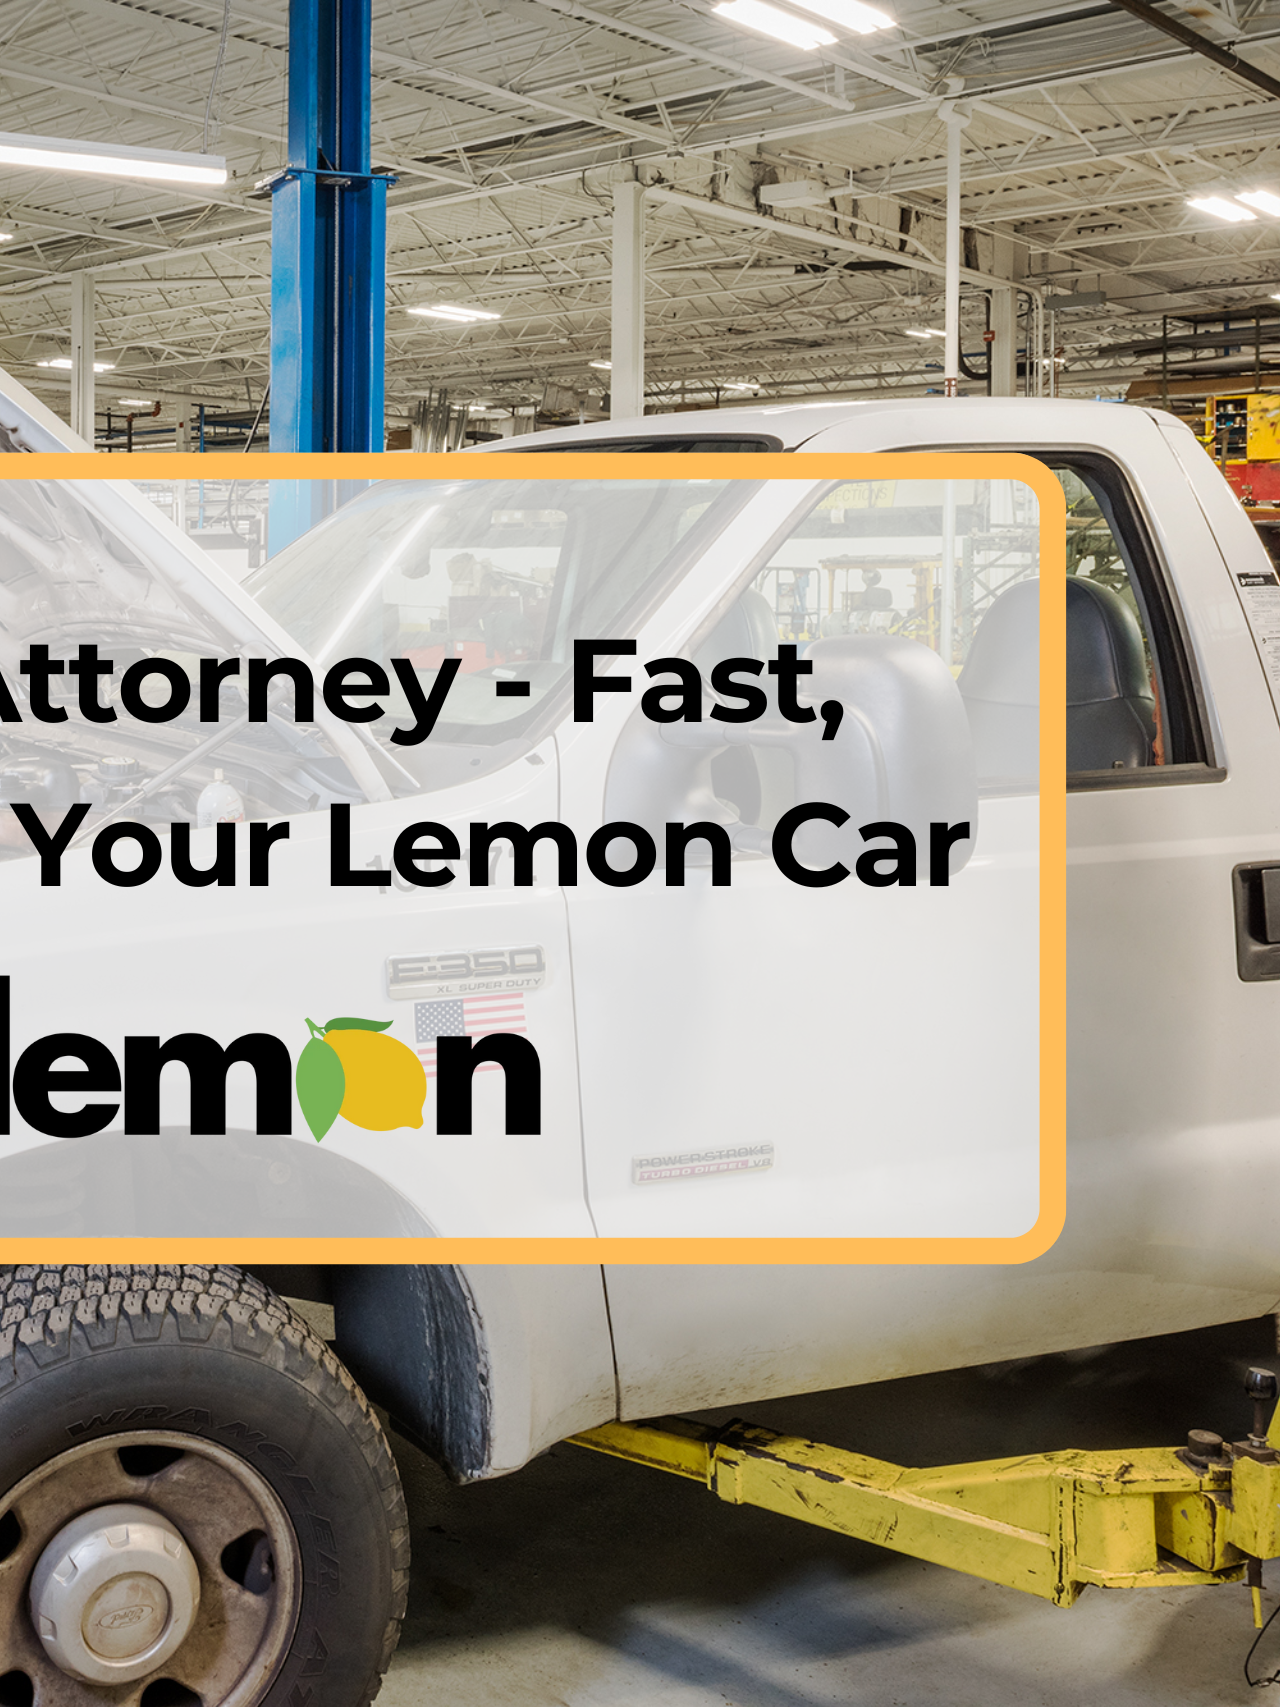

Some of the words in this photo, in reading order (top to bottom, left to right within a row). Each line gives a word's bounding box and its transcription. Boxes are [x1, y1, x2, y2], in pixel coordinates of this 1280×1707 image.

[392, 948, 543, 984] F-350
[436, 985, 453, 994] XL
[459, 981, 502, 992] SUPER
[506, 978, 542, 988] DUTY
[642, 1166, 691, 1180] TURBO
[694, 1161, 747, 1174] DIESEL
[753, 1157, 771, 1168] V8
[65, 1404, 341, 1596] WRANGLER
[110, 1607, 144, 1626] Ford
